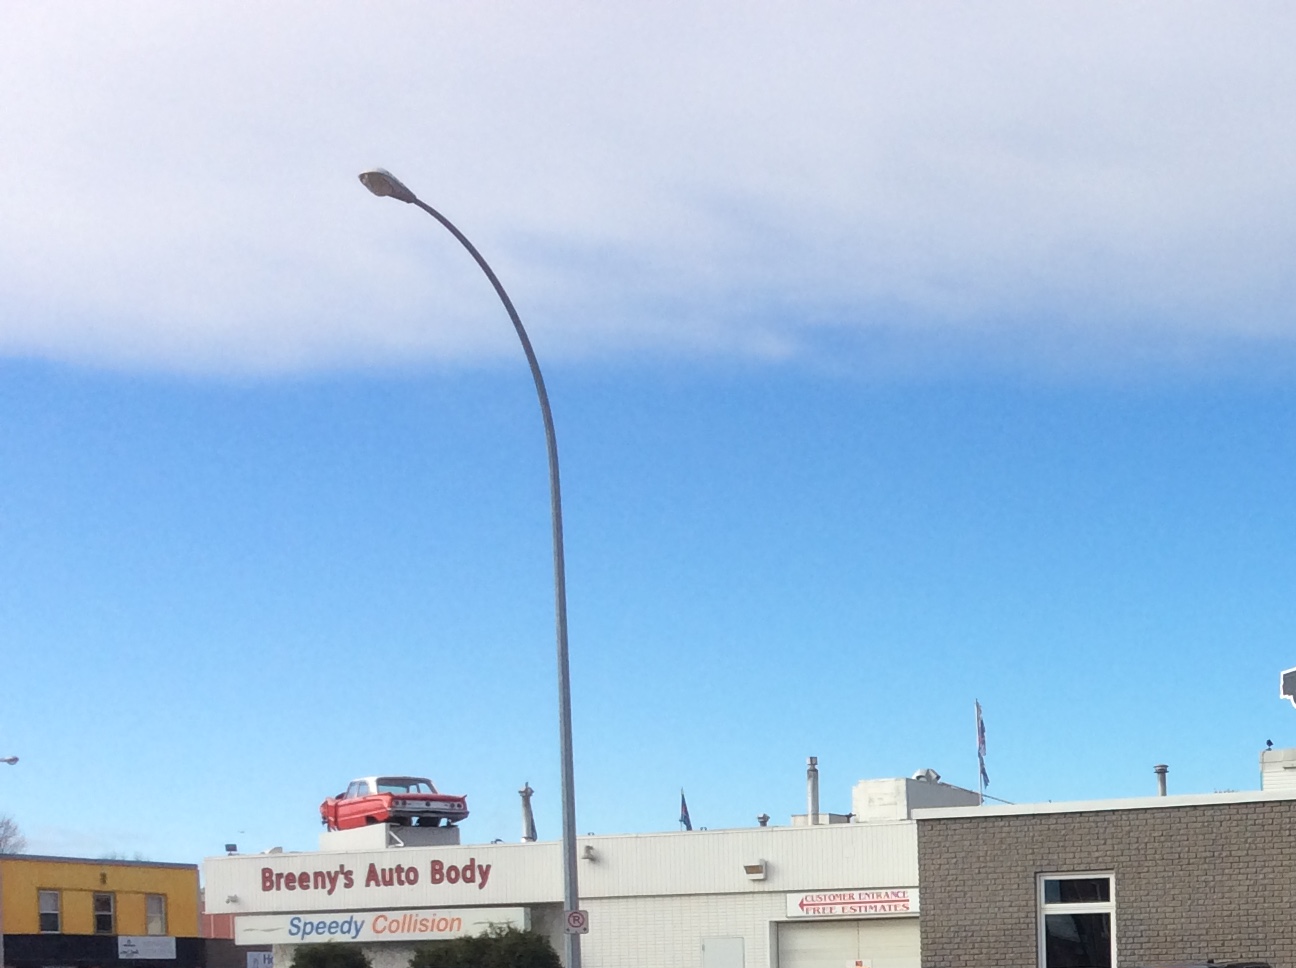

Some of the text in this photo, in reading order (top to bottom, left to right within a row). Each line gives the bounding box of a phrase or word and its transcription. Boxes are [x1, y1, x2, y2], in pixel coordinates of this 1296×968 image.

[261, 857, 492, 895] Breeny's Auto Body
[804, 890, 908, 902] CUSTOMER ENTRANCE
[805, 903, 910, 915] FREE ESTIMATES
[288, 913, 462, 940] Speedy Collision
